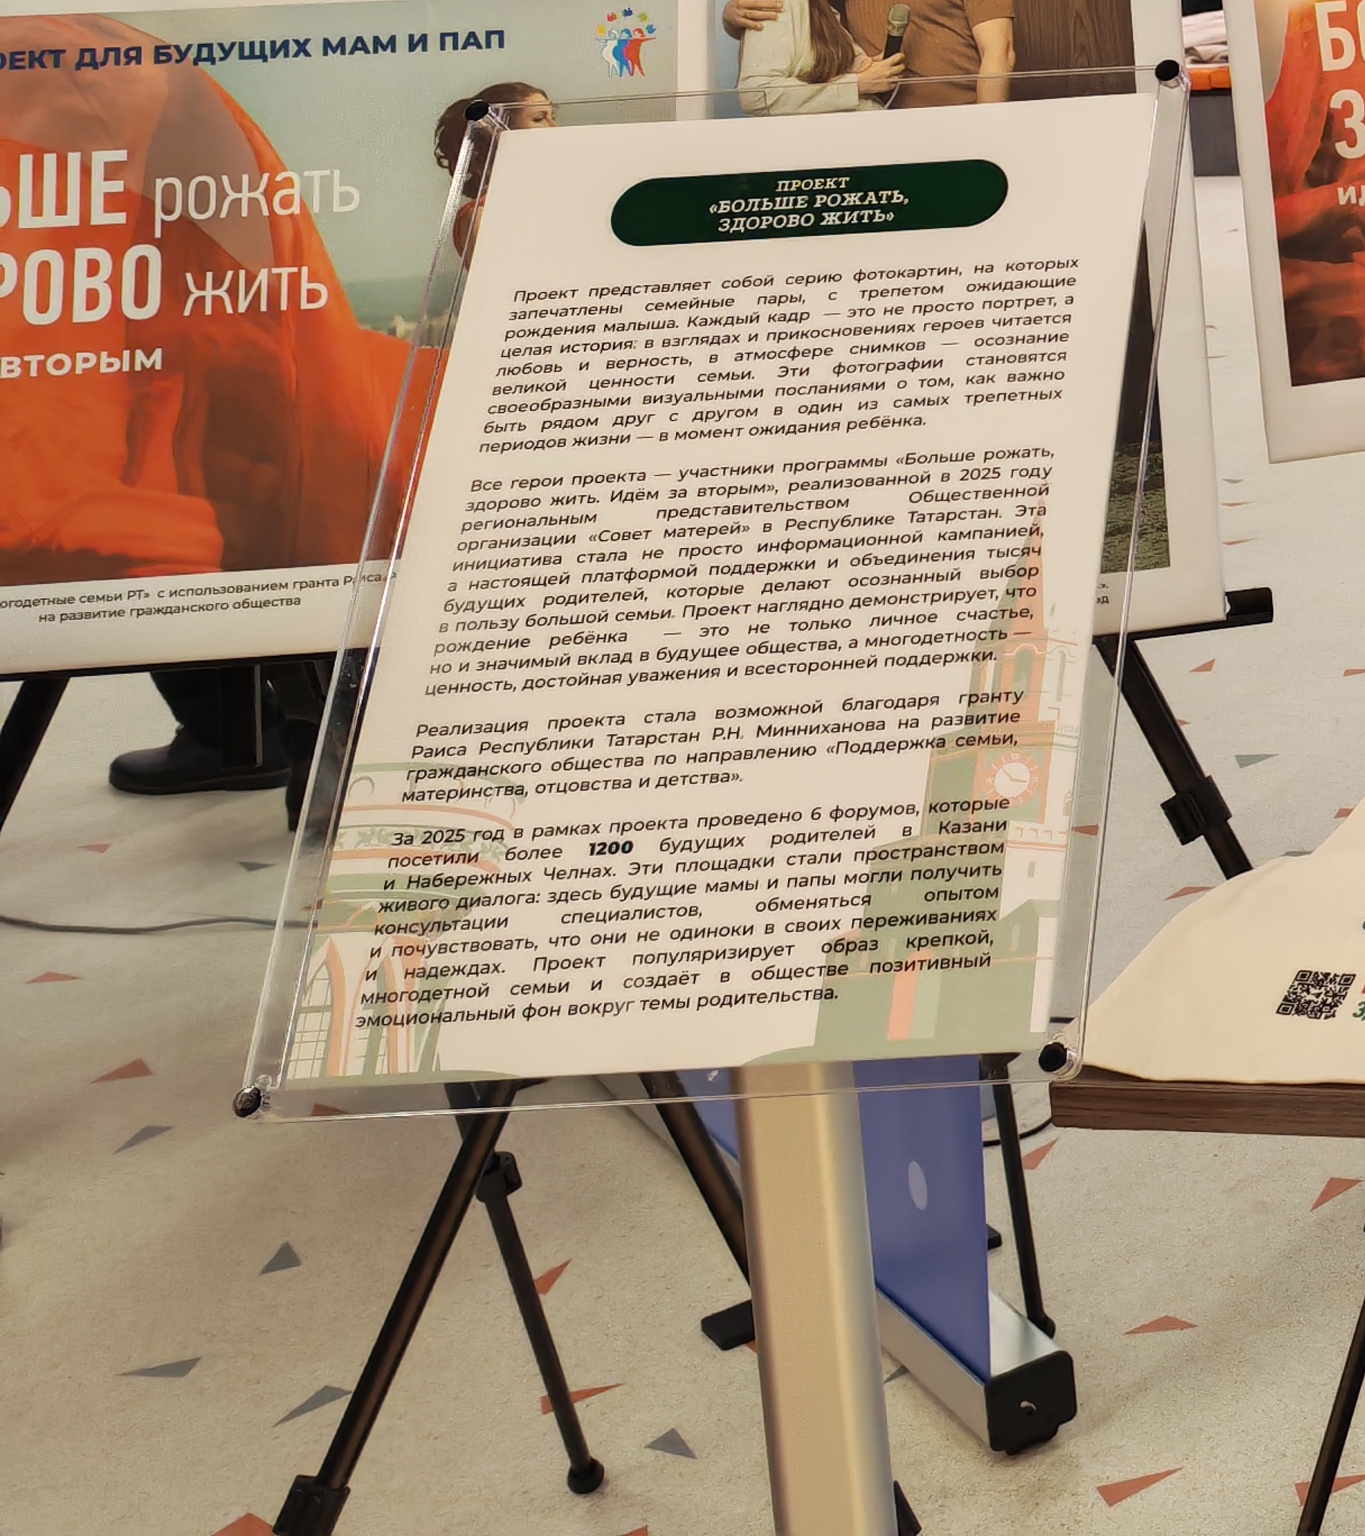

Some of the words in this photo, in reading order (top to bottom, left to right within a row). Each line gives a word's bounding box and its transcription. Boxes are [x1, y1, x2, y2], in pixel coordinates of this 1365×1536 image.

[75, 45, 142, 71] ДЛЯ
[153, 37, 313, 68] БУДУЩИХ
[322, 33, 397, 57] МАМ
[440, 29, 506, 52] ПАП
[154, 170, 361, 238] рожать
[708, 195, 809, 215] «БОЛЬШЕ
[813, 189, 910, 208] РОЖАТЬ,
[775, 177, 851, 192] ПРОЕКТ
[718, 213, 815, 234] ЗДОРОВО
[819, 209, 895, 226] ЖИТЬ»
[183, 265, 329, 317] жить
[508, 304, 623, 321] запечатлены
[644, 296, 735, 312] семейные
[756, 294, 806, 307] пары,
[828, 292, 838, 301] с
[858, 285, 944, 302] трепетом
[966, 277, 1076, 292] ожидающие
[514, 288, 579, 304] Проект
[588, 280, 712, 300] представляет
[721, 274, 774, 289] собой
[785, 273, 843, 287] серию
[852, 266, 962, 284] фотокартин,
[974, 264, 994, 274] на
[1005, 259, 1079, 272] которых
[0, 348, 163, 379] ВТОРЫМ
[465, 497, 542, 514] здорово
[550, 494, 600, 506] жить.
[610, 488, 659, 504] Идём
[668, 488, 688, 500] за
[696, 484, 779, 499] вторым»,
[788, 470, 931, 495] реализованной
[940, 472, 950, 482] в
[959, 466, 1001, 482] 2025
[1010, 466, 1052, 480] году
[38, 612, 56, 623] на
[59, 606, 126, 624] развитие
[129, 601, 230, 619] гражданского
[233, 596, 302, 611] общества
[411, 745, 467, 760] Раиса
[478, 736, 594, 756] Республики
[606, 731, 700, 748] Татарстан
[712, 726, 744, 741] Р.Н.
[756, 720, 886, 738] Минниханова
[898, 718, 920, 730] на
[931, 712, 1020, 730] развитие
[383, 879, 396, 891] и
[406, 871, 532, 890] Набережных
[543, 866, 616, 881] Челнах.
[628, 862, 664, 876] Эти
[675, 856, 775, 874] площадки
[786, 852, 842, 866] стали
[854, 842, 1004, 865] пространством
